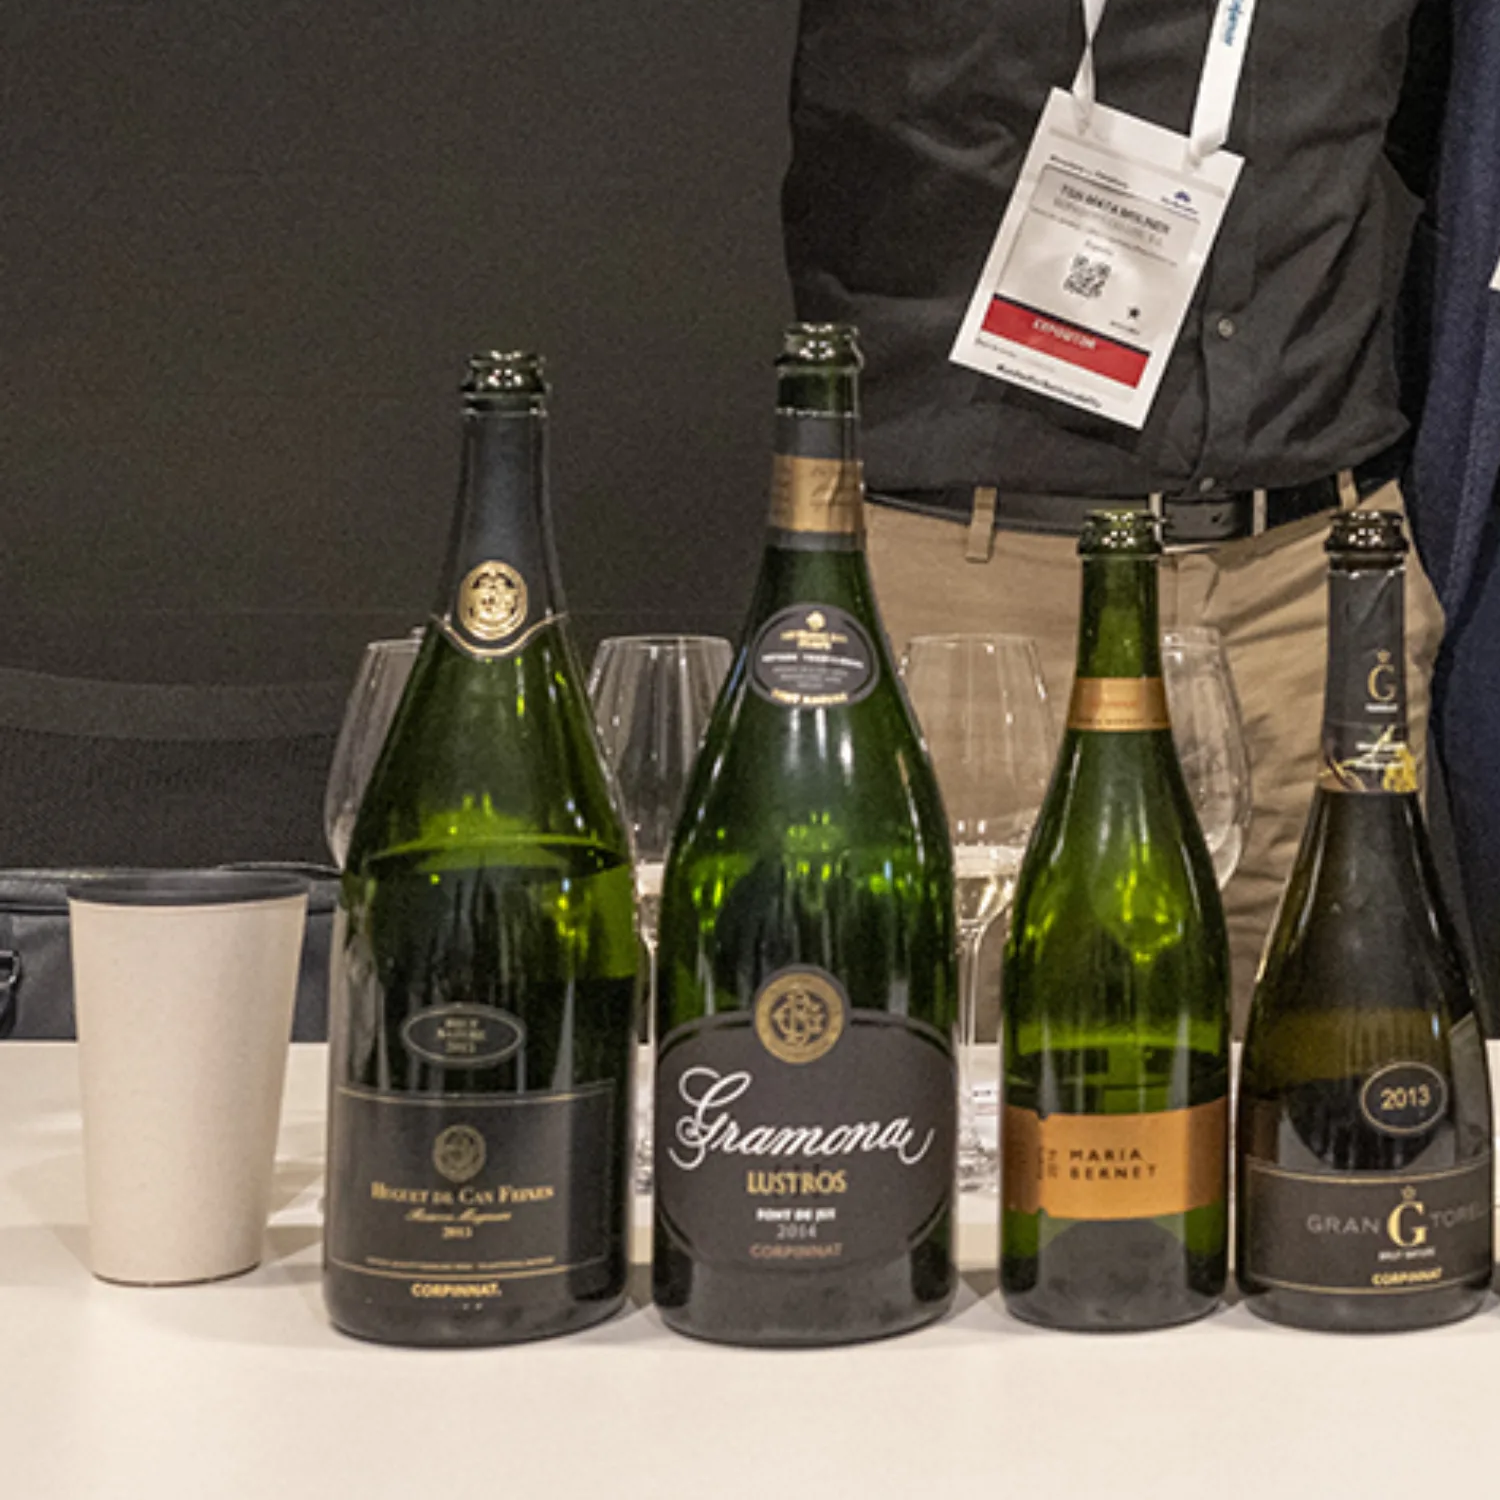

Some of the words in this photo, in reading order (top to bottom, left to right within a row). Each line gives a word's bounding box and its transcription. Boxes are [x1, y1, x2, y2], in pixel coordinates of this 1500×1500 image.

[1380, 1083, 1432, 1111] 2013
[667, 1066, 936, 1170] Gramona
[1069, 1148, 1142, 1162] MARIA
[746, 1169, 849, 1197] LUSTROS
[1306, 1213, 1381, 1235] GRAN
